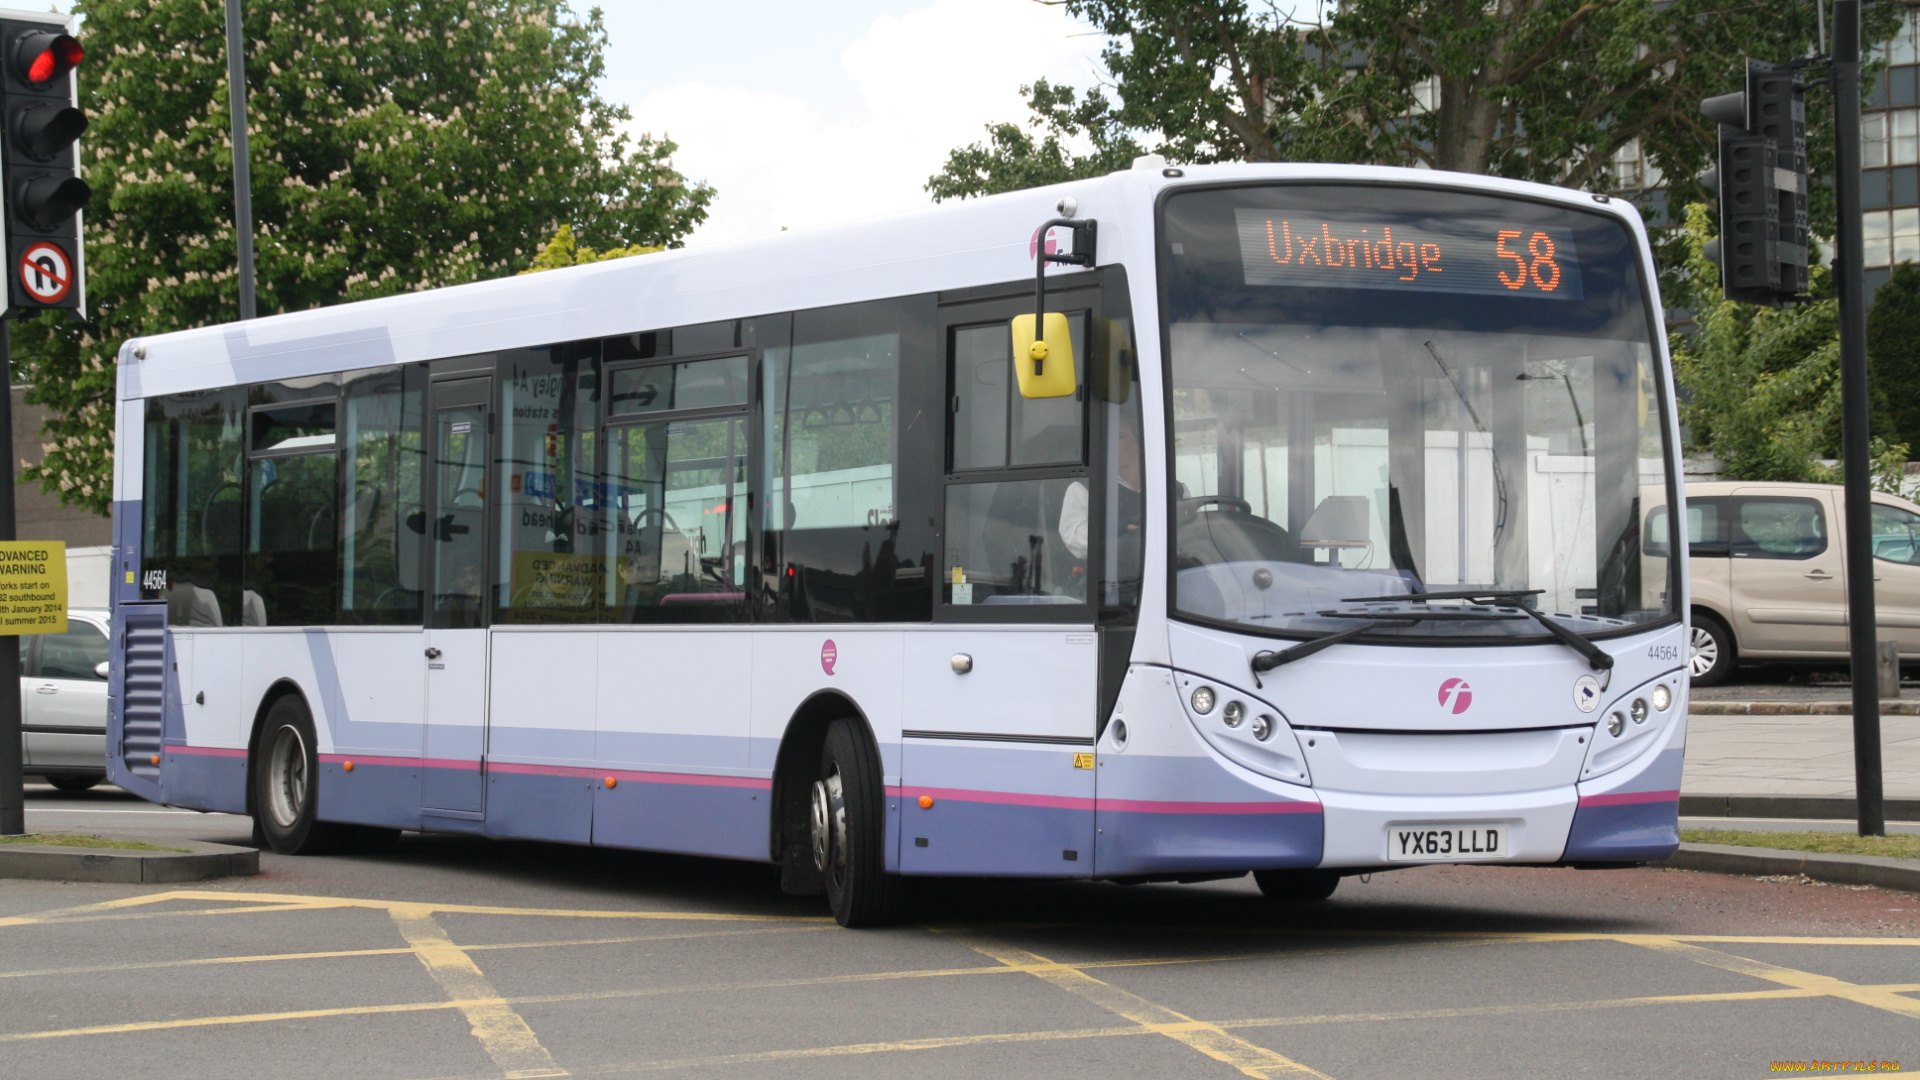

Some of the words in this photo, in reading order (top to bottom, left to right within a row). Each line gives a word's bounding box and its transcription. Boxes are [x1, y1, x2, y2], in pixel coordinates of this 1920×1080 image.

[1266, 220, 1443, 281] Uxbridge
[1496, 230, 1561, 291] 58
[0, 550, 48, 561] DVANCED
[143, 569, 167, 590] 44564
[0, 582, 18, 590] orks
[20, 582, 38, 590] start
[9, 592, 56, 602] southbound
[11, 605, 43, 615] January
[44, 603, 63, 613] 2014
[5, 616, 37, 625] summer
[38, 615, 57, 624] 2015
[1647, 645, 1678, 661] 44564
[1398, 830, 1452, 855] YX63
[1458, 829, 1498, 853] LLD
